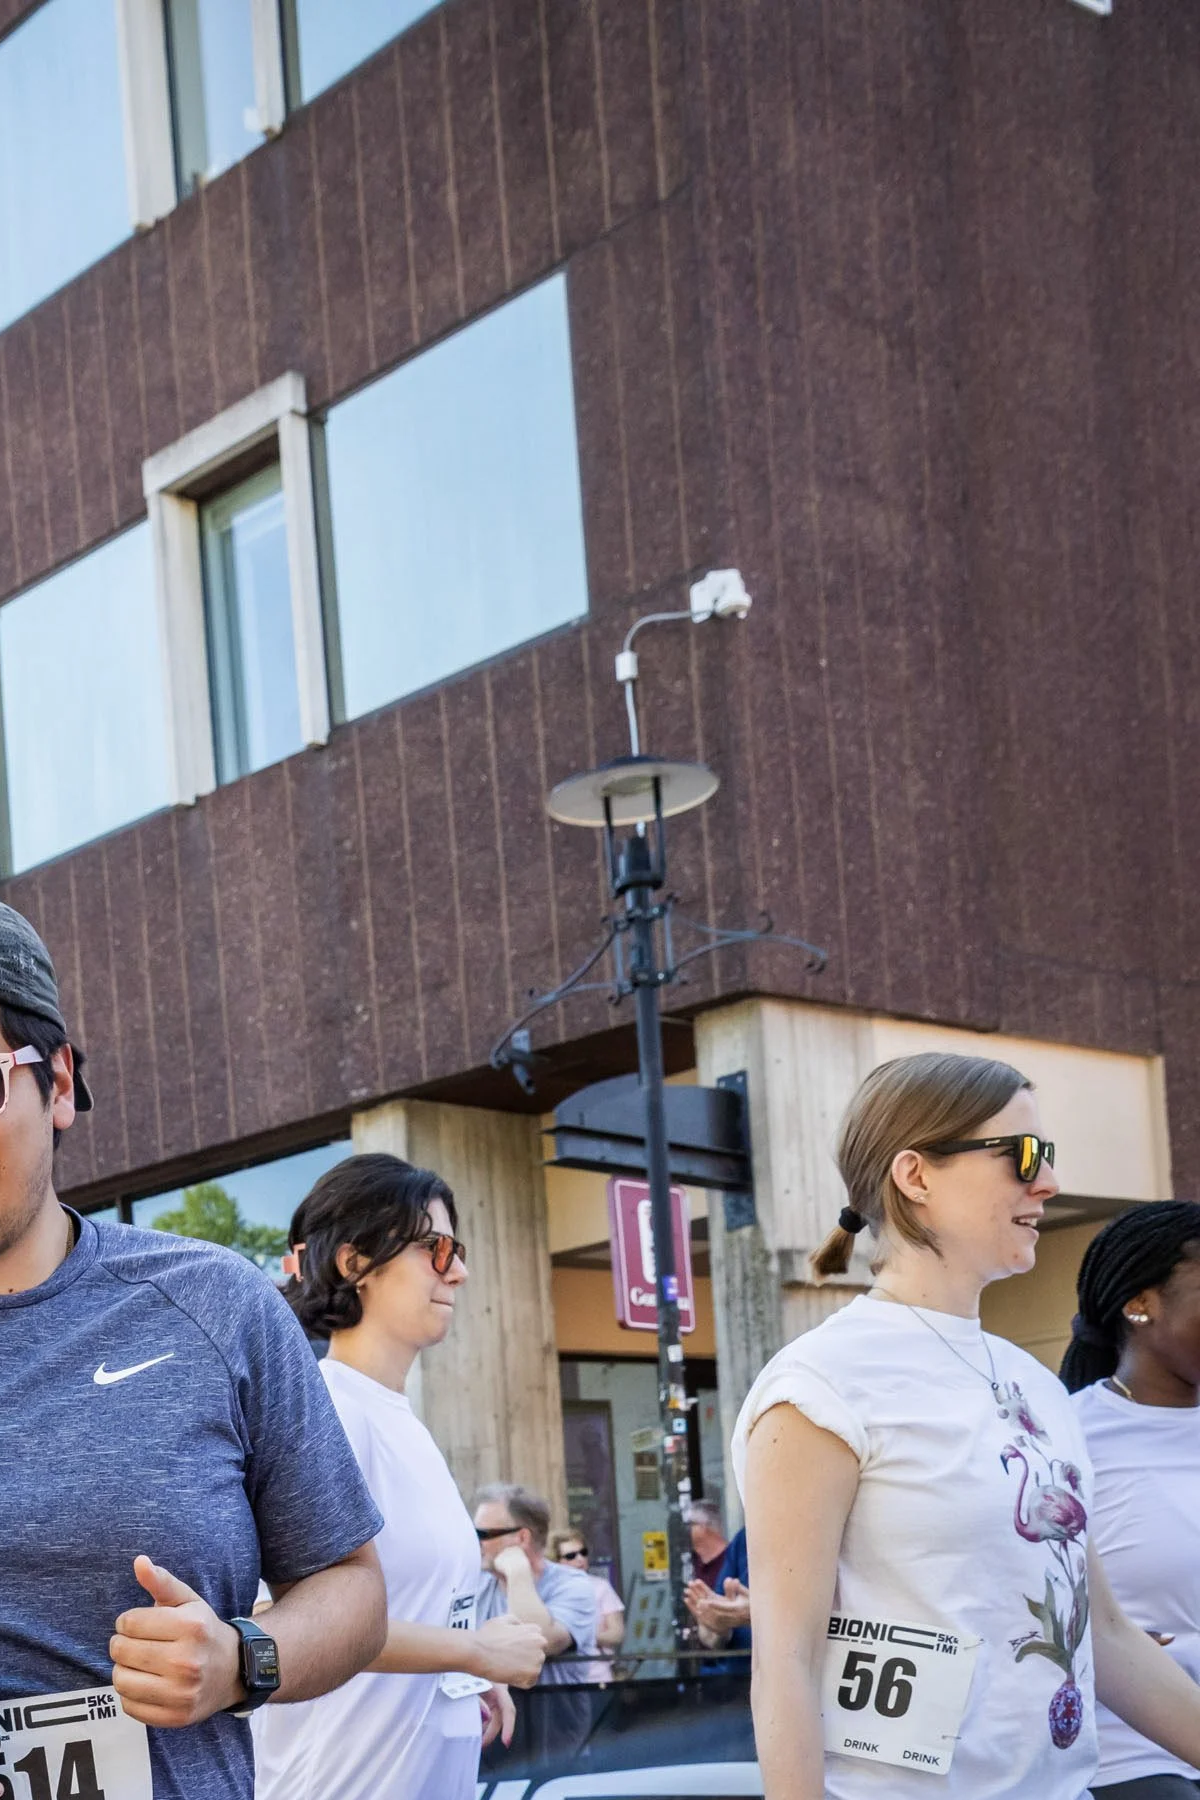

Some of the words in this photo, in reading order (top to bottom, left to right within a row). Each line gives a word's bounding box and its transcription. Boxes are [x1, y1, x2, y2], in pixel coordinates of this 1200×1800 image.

[827, 1617, 937, 1650] BIONIC
[838, 1650, 917, 1718] 56
[844, 1738, 879, 1753] DRINK
[903, 1750, 940, 1766] DRINK
